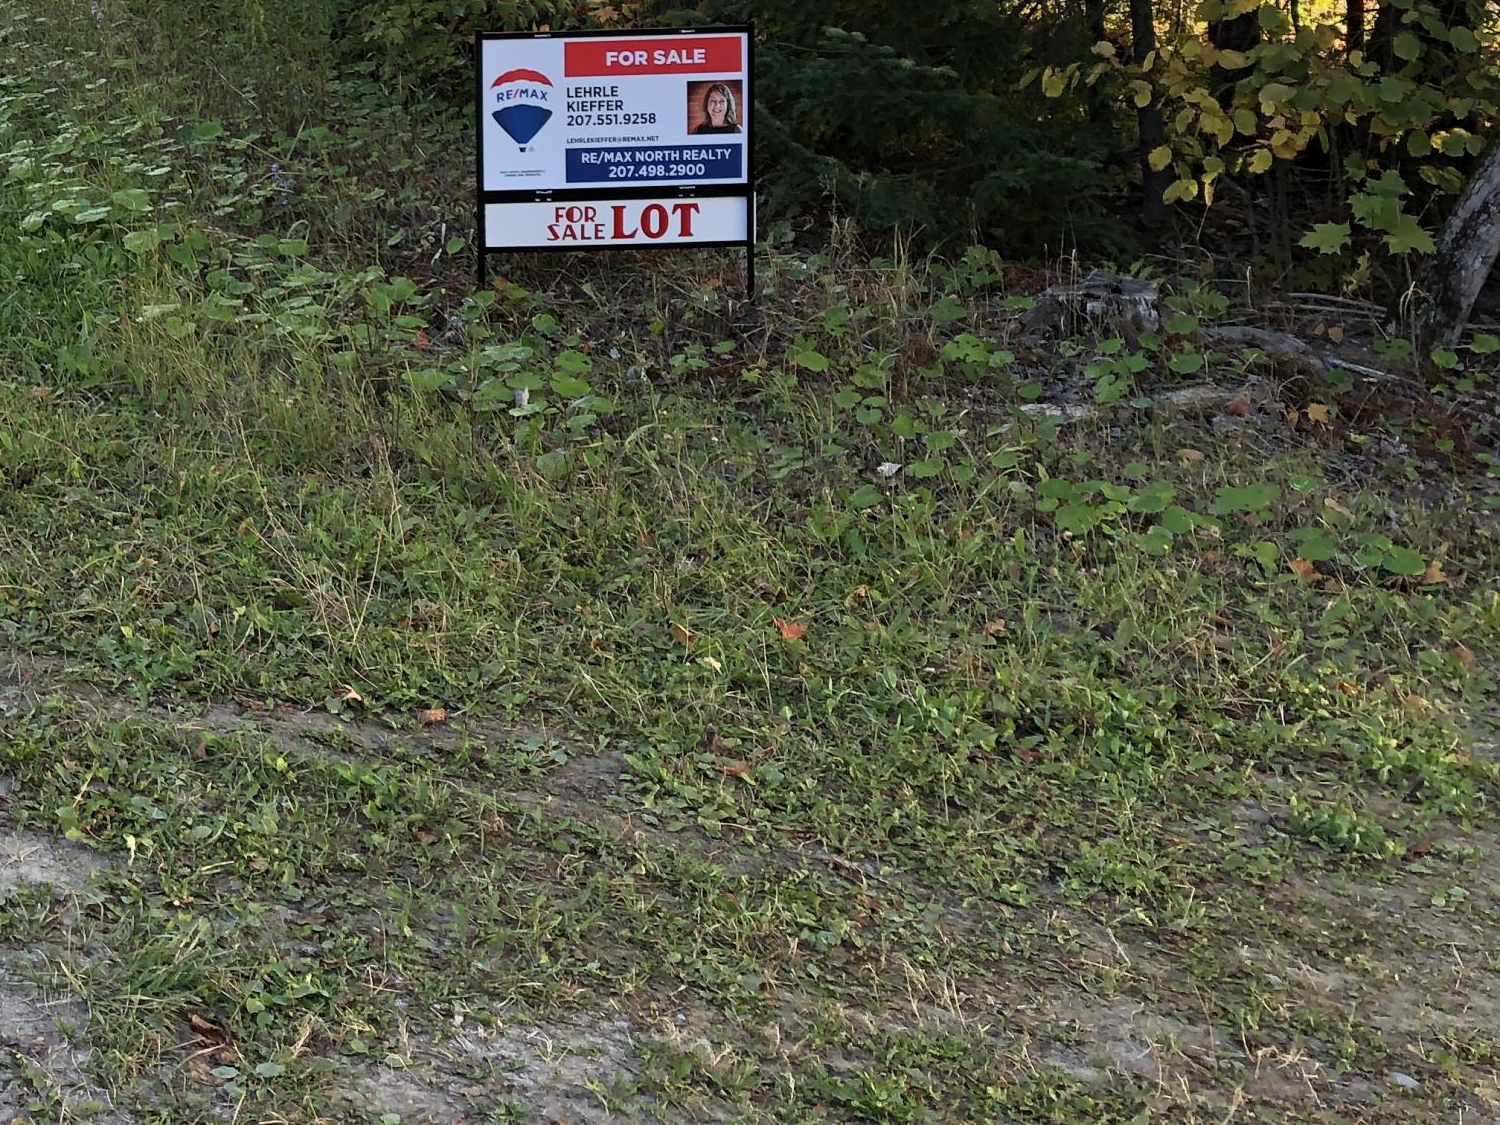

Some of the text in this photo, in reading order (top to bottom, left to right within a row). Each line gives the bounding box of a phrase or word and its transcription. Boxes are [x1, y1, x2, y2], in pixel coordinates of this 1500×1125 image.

[605, 48, 706, 67] FOR SALE
[496, 87, 549, 103] RE/MAX
[566, 85, 619, 99] LEHRLE
[566, 100, 624, 113] KIEFFER
[566, 113, 657, 127] 207.551.9258
[581, 148, 732, 164] RE/MAX NORTH REALTY
[608, 163, 705, 179] 207.498.2900
[546, 202, 701, 241] SALE LOT
[554, 206, 597, 223] FOR
